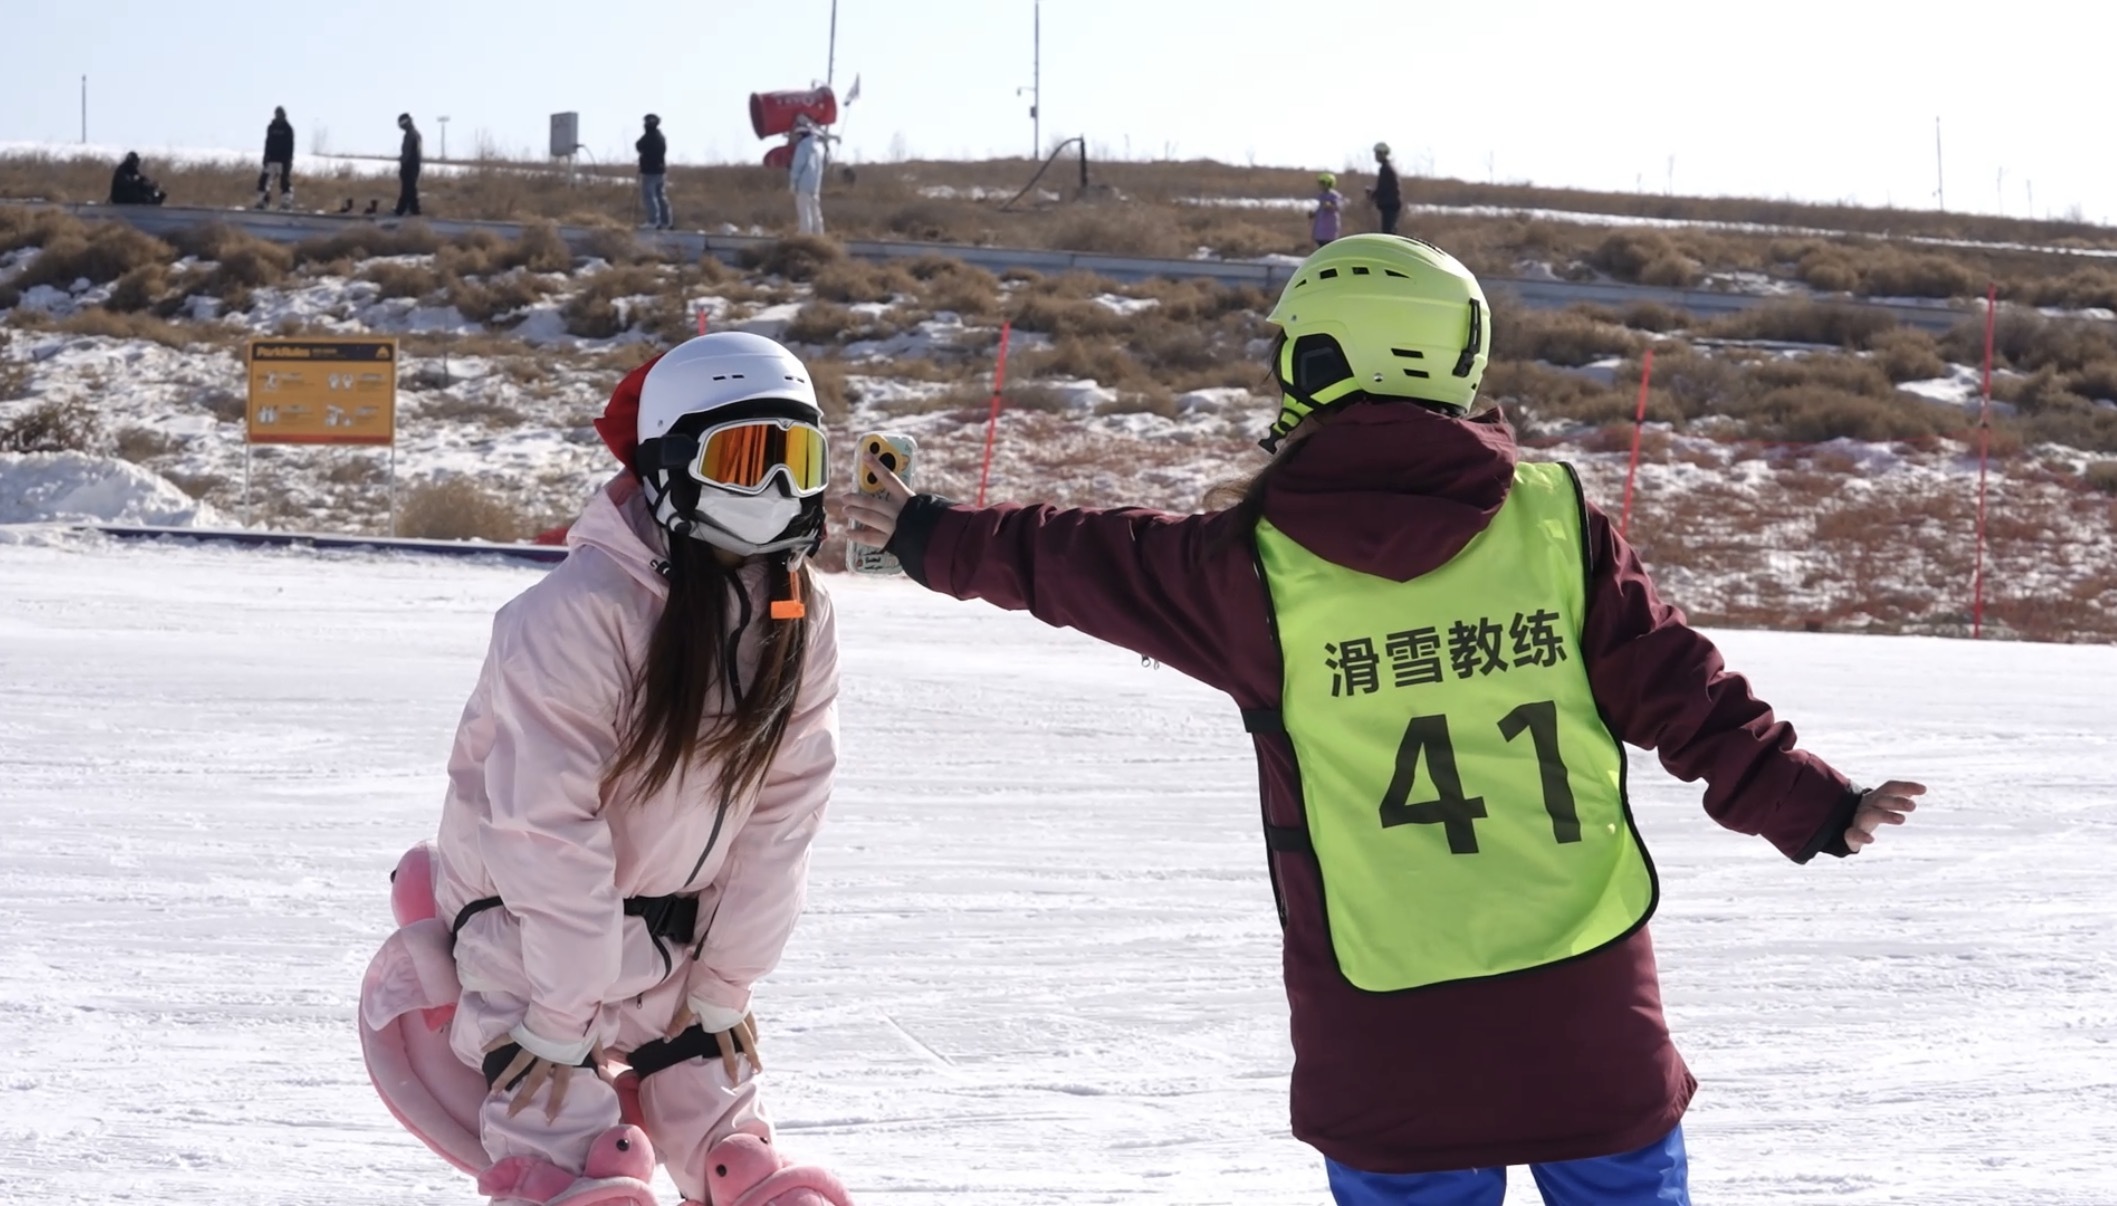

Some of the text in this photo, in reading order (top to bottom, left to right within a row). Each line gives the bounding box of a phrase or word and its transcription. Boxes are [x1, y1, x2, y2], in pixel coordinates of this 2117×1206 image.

[1324, 608, 1568, 697] 滑雪教练
[1379, 700, 1582, 854] 41
